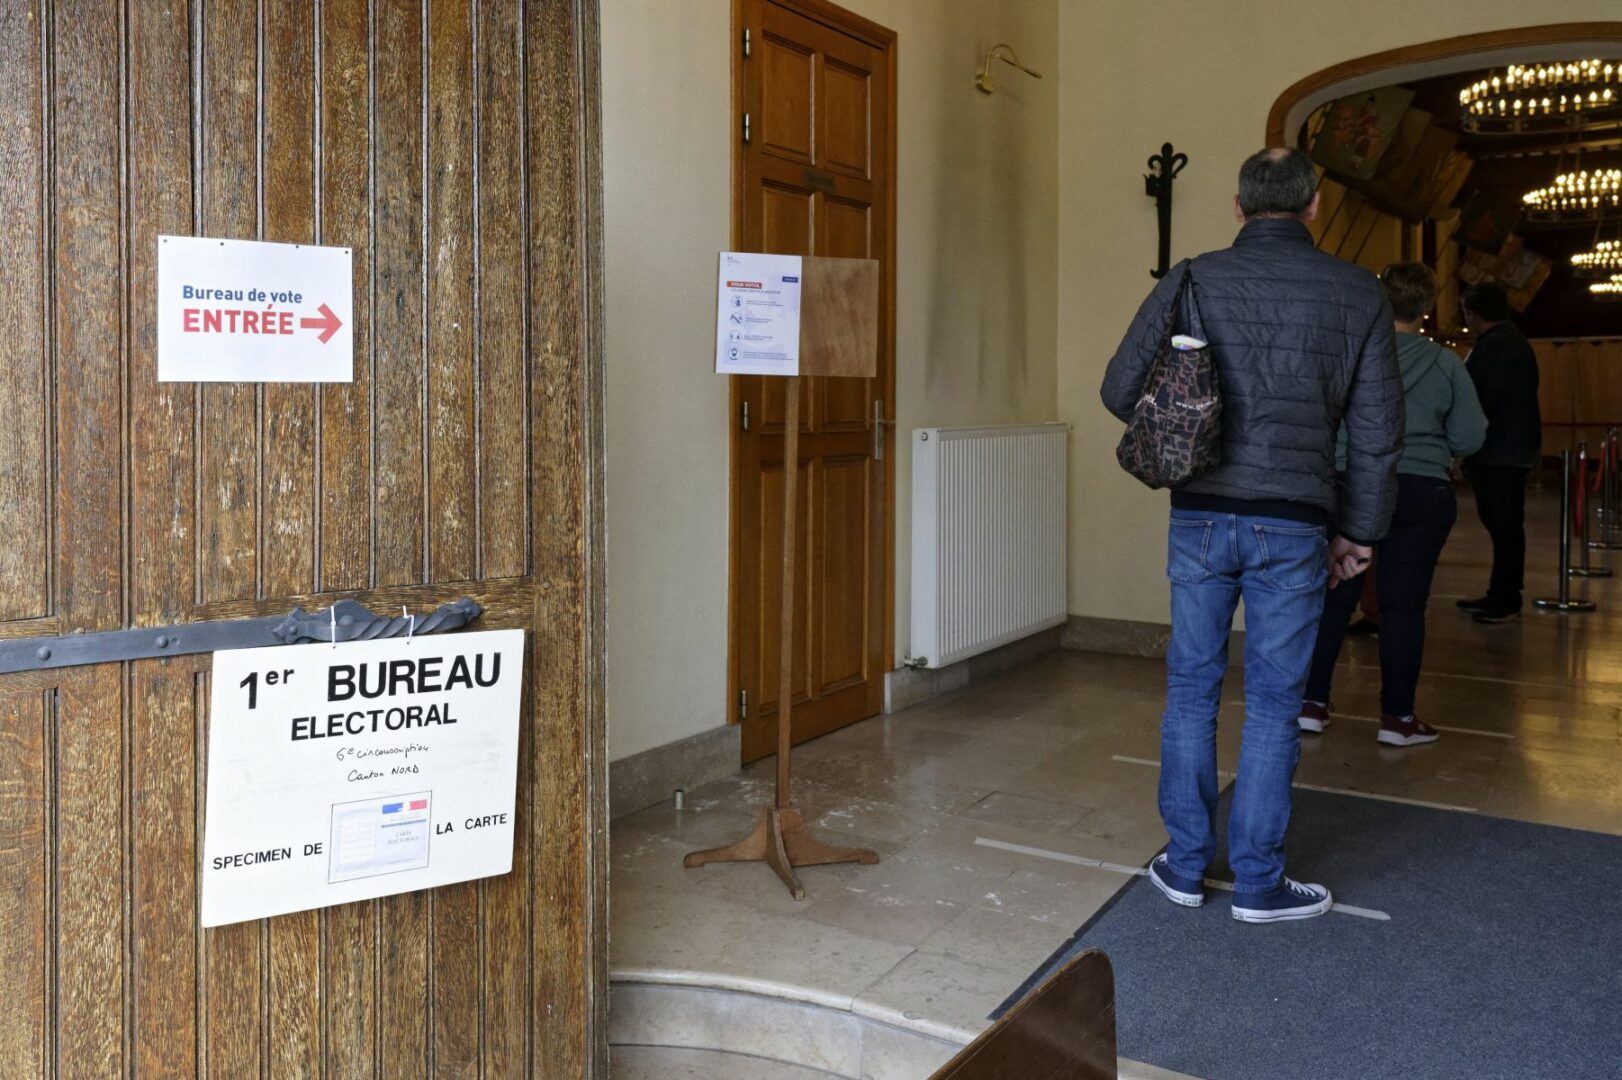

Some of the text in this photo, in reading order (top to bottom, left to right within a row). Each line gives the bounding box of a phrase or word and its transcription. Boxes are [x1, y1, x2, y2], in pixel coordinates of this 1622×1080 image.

[182, 285, 303, 303] Bureau de vote
[183, 304, 294, 335] ENTRÉE
[239, 652, 502, 710] 1er BUREAU
[291, 702, 457, 741] ELECTORAL
[347, 764, 420, 782] Canton NORD
[435, 813, 508, 835] LA CARTE
[212, 843, 323, 870] SPECIMEN DE
